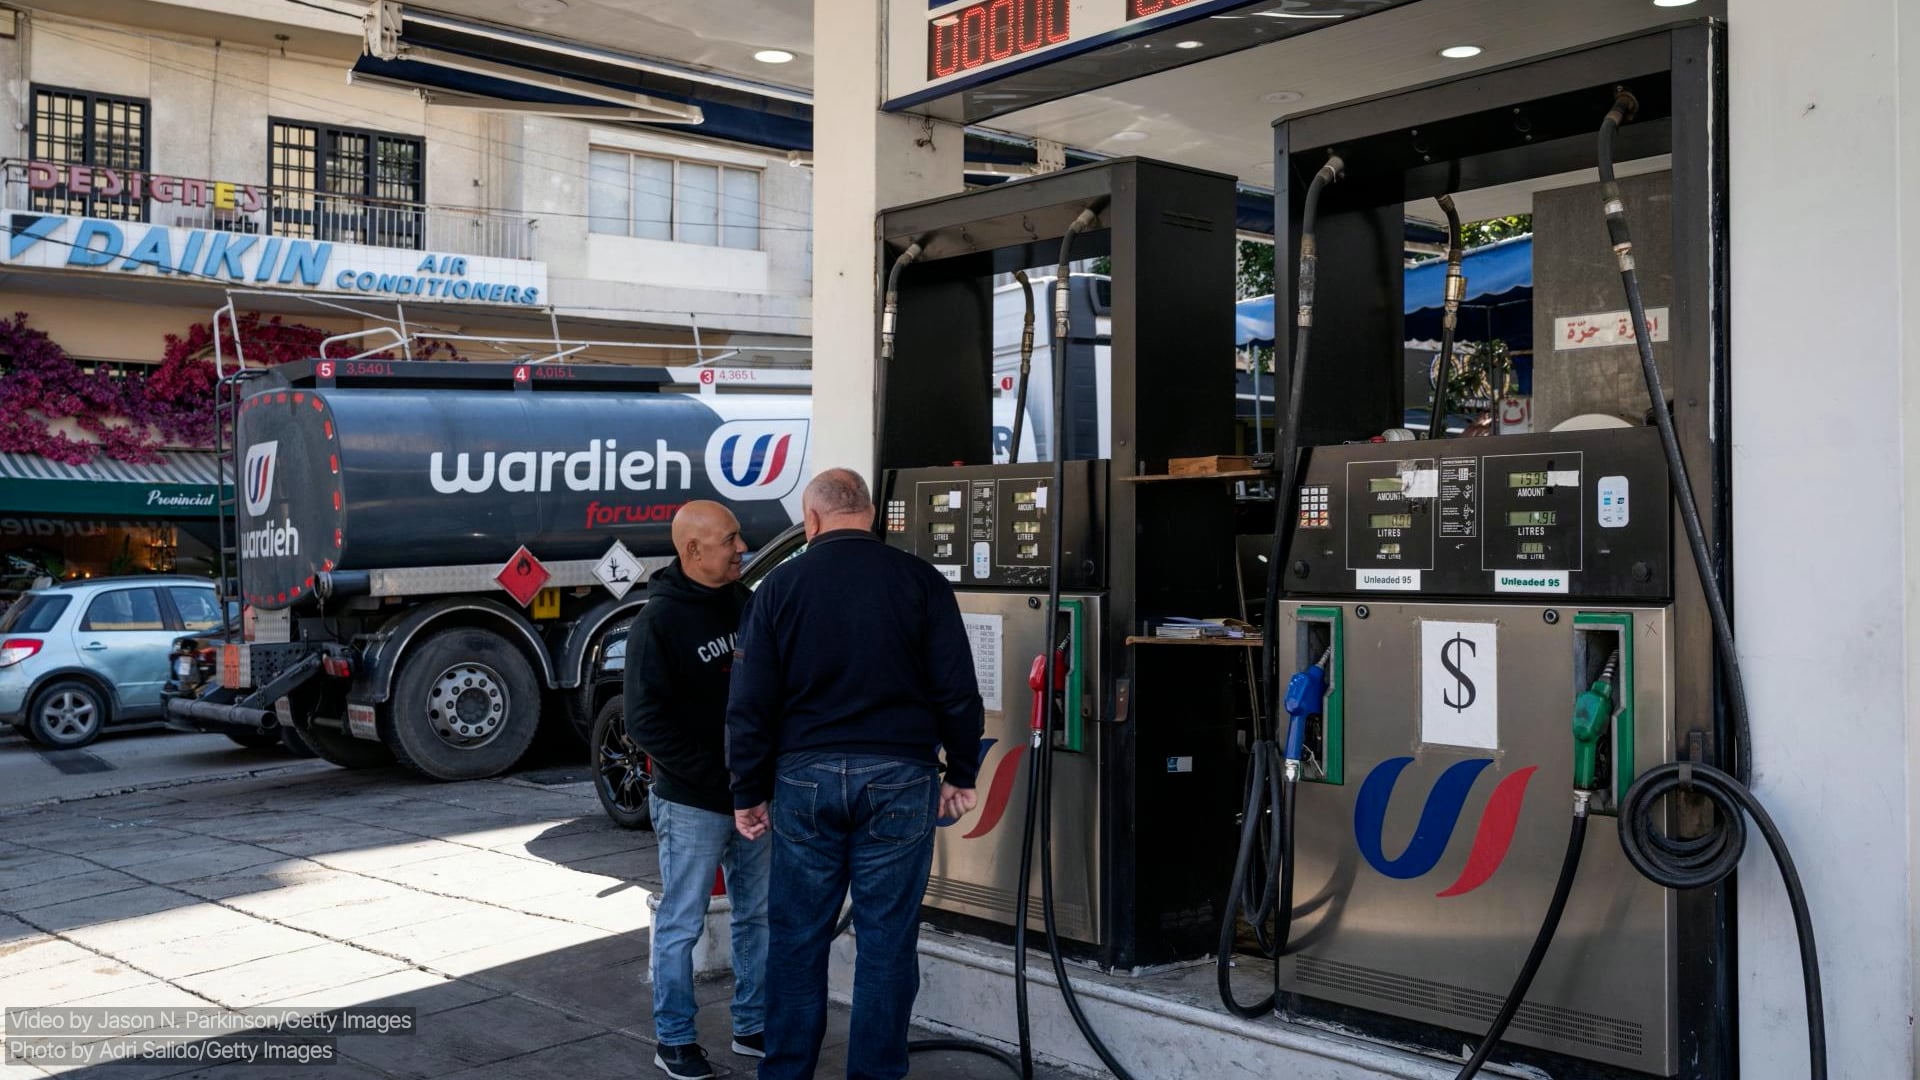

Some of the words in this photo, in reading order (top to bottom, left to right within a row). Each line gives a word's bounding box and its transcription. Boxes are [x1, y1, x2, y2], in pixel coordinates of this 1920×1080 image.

[66, 218, 333, 285] DAIKIN
[417, 254, 467, 276] AIR
[336, 269, 539, 305] CONDITIONERS
[321, 363, 332, 377] 5
[346, 362, 384, 376] 3,540
[387, 362, 395, 376] L
[516, 367, 526, 381] 4
[703, 371, 712, 385] 3
[720, 370, 748, 381] 4,365
[430, 439, 691, 494] wardieh
[147, 489, 215, 506] Provincial
[1517, 488, 1545, 497] AMOUNT
[585, 499, 692, 529] forwar
[241, 518, 299, 559] wardieh
[1377, 528, 1401, 537] LITRES
[1517, 527, 1545, 536] LITRES
[1364, 575, 1400, 584] Unleaded
[1402, 575, 1412, 584] 95
[1501, 576, 1546, 586] Unleaded
[1548, 578, 1561, 587] 95
[1441, 631, 1476, 714] $
